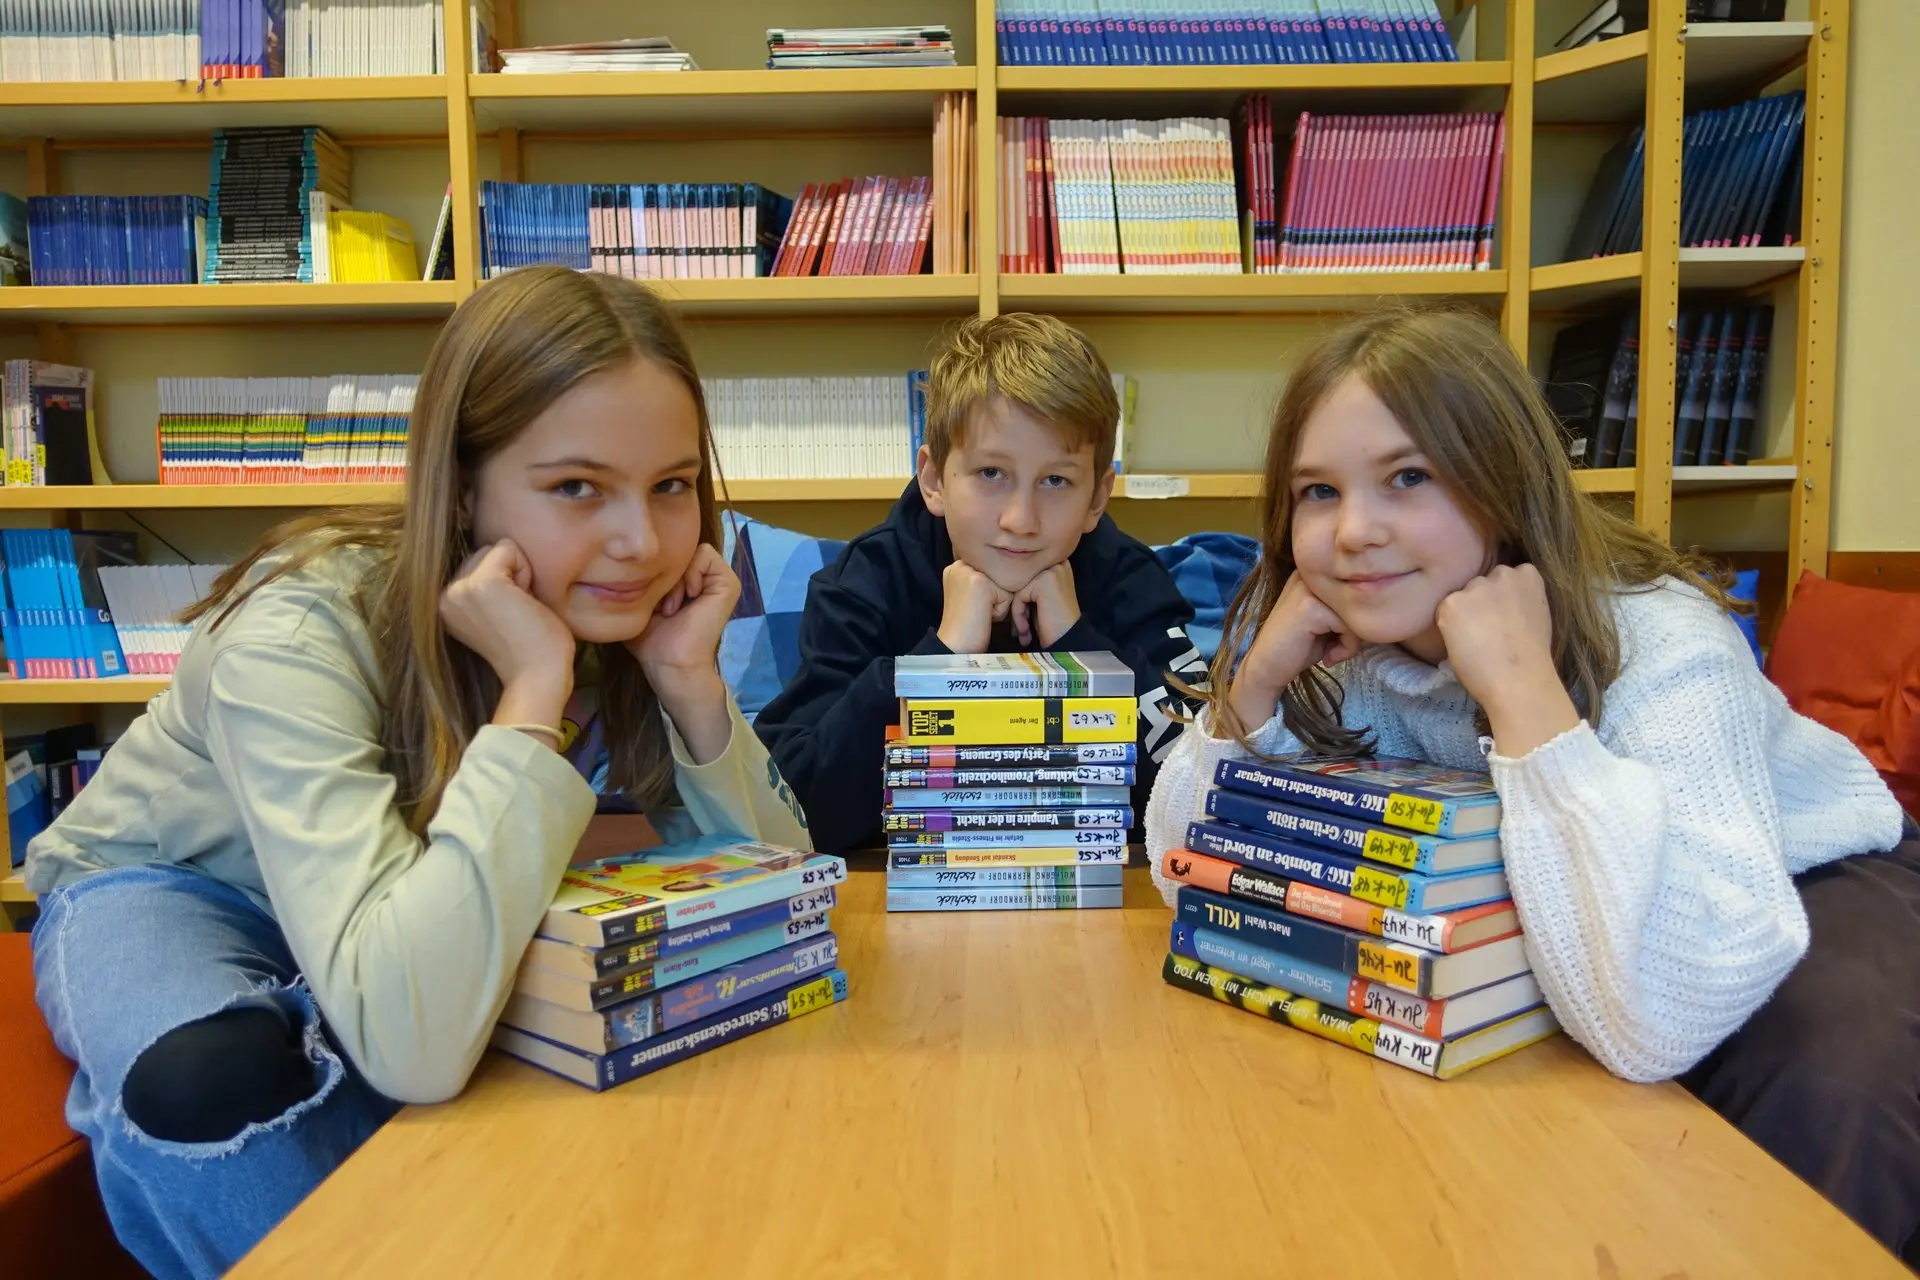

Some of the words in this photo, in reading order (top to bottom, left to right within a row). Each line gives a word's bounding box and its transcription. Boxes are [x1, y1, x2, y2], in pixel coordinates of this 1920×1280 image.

[947, 679, 988, 692] tschick
[911, 711, 929, 735] TOP
[1010, 717, 1027, 725] Agent
[1046, 716, 1060, 725] cbt
[960, 750, 1002, 761] Grauens
[1004, 750, 1021, 761] des
[1022, 747, 1050, 761] Party
[958, 771, 1034, 784] Promihochzeit!
[1234, 769, 1272, 787] Jaguar
[1272, 776, 1288, 791] im
[941, 791, 982, 803] tschick
[956, 815, 986, 827] Nacht
[987, 815, 1004, 826] der
[1005, 815, 1013, 826] in
[1017, 812, 1059, 826] Vampire
[1266, 810, 1299, 831] Hölle
[1223, 839, 1255, 861] Bord
[1256, 850, 1274, 864] an
[936, 871, 976, 883] tschick
[1231, 873, 1255, 892] Edgar
[1254, 878, 1286, 898] Wallace
[936, 895, 977, 907] tschick
[1204, 902, 1240, 930] KILL
[1244, 914, 1268, 930] Wahl
[1268, 920, 1291, 937] Mats
[1173, 964, 1195, 976] TOD
[1195, 970, 1219, 988] DEM
[1219, 980, 1239, 995] MIT
[1240, 986, 1274, 1007] NICHT
[1278, 1000, 1310, 1020] SPIEL
